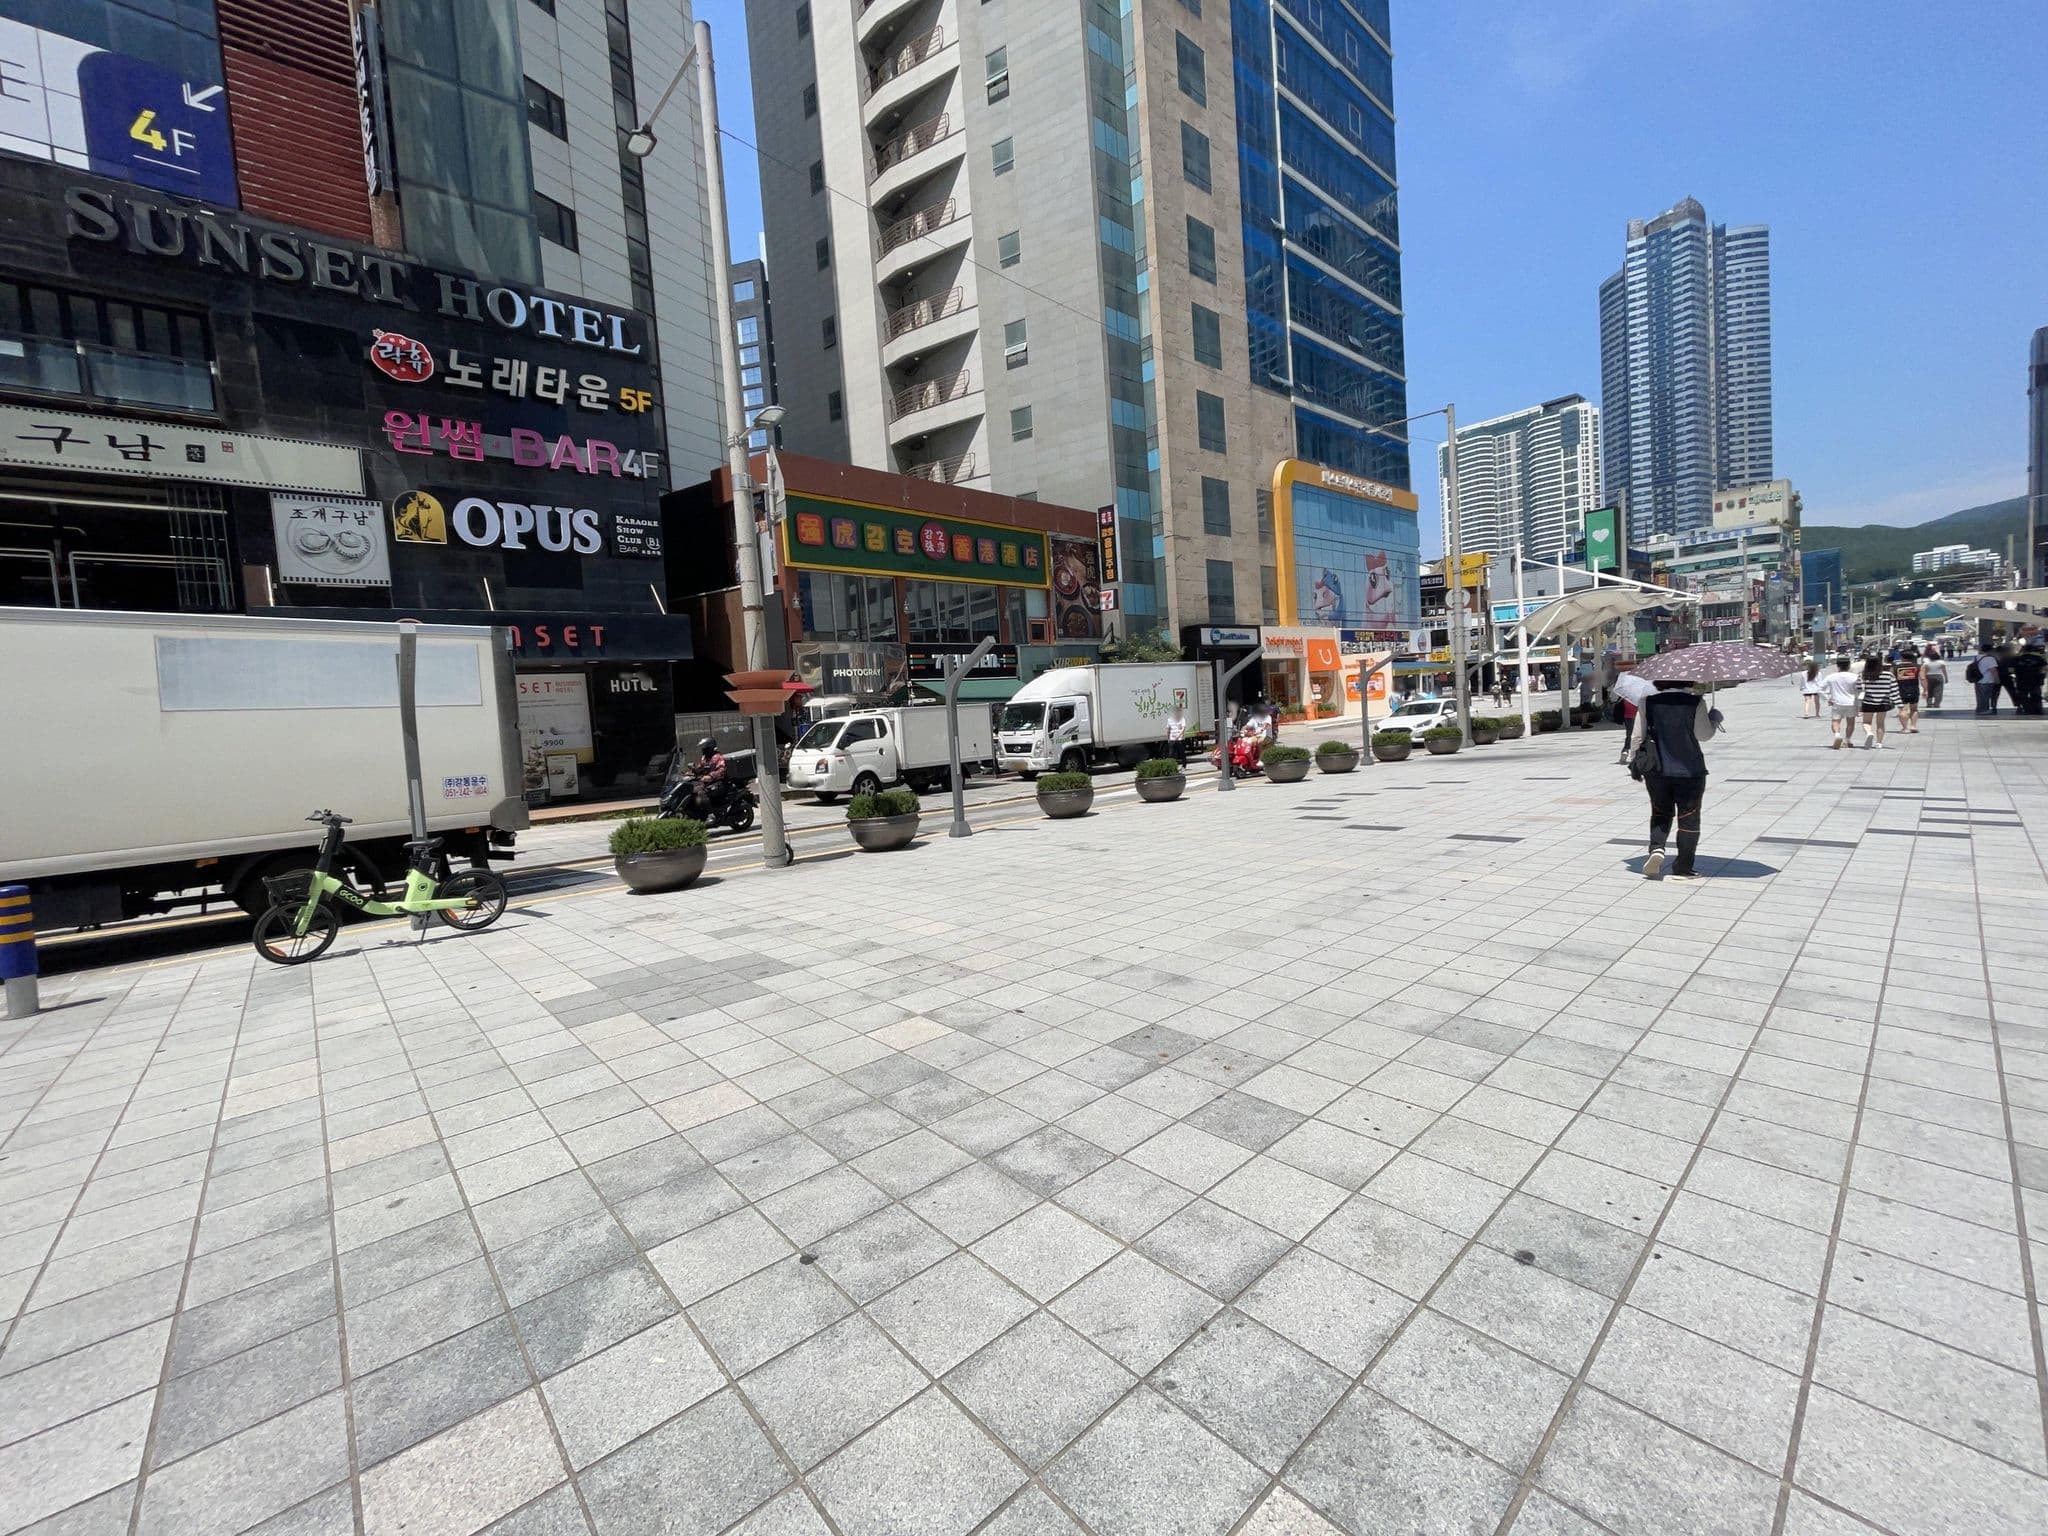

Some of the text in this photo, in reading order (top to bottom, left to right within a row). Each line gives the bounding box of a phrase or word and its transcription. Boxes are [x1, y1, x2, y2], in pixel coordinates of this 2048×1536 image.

[63, 186, 641, 355] SUNSET HOTEL
[444, 348, 611, 411] 노래타운
[618, 386, 653, 414] 5F
[15, 423, 166, 463] 구남
[510, 427, 622, 478] BAR
[621, 448, 659, 479] 4F
[290, 508, 370, 526] 조개구남
[452, 497, 602, 554] OPUS
[615, 515, 660, 527] KARAOKE
[616, 525, 644, 535] SHOW
[617, 535, 642, 545] CLUB
[833, 668, 881, 678] PHOTOGRAY
[338, 889, 364, 905] GCOO
